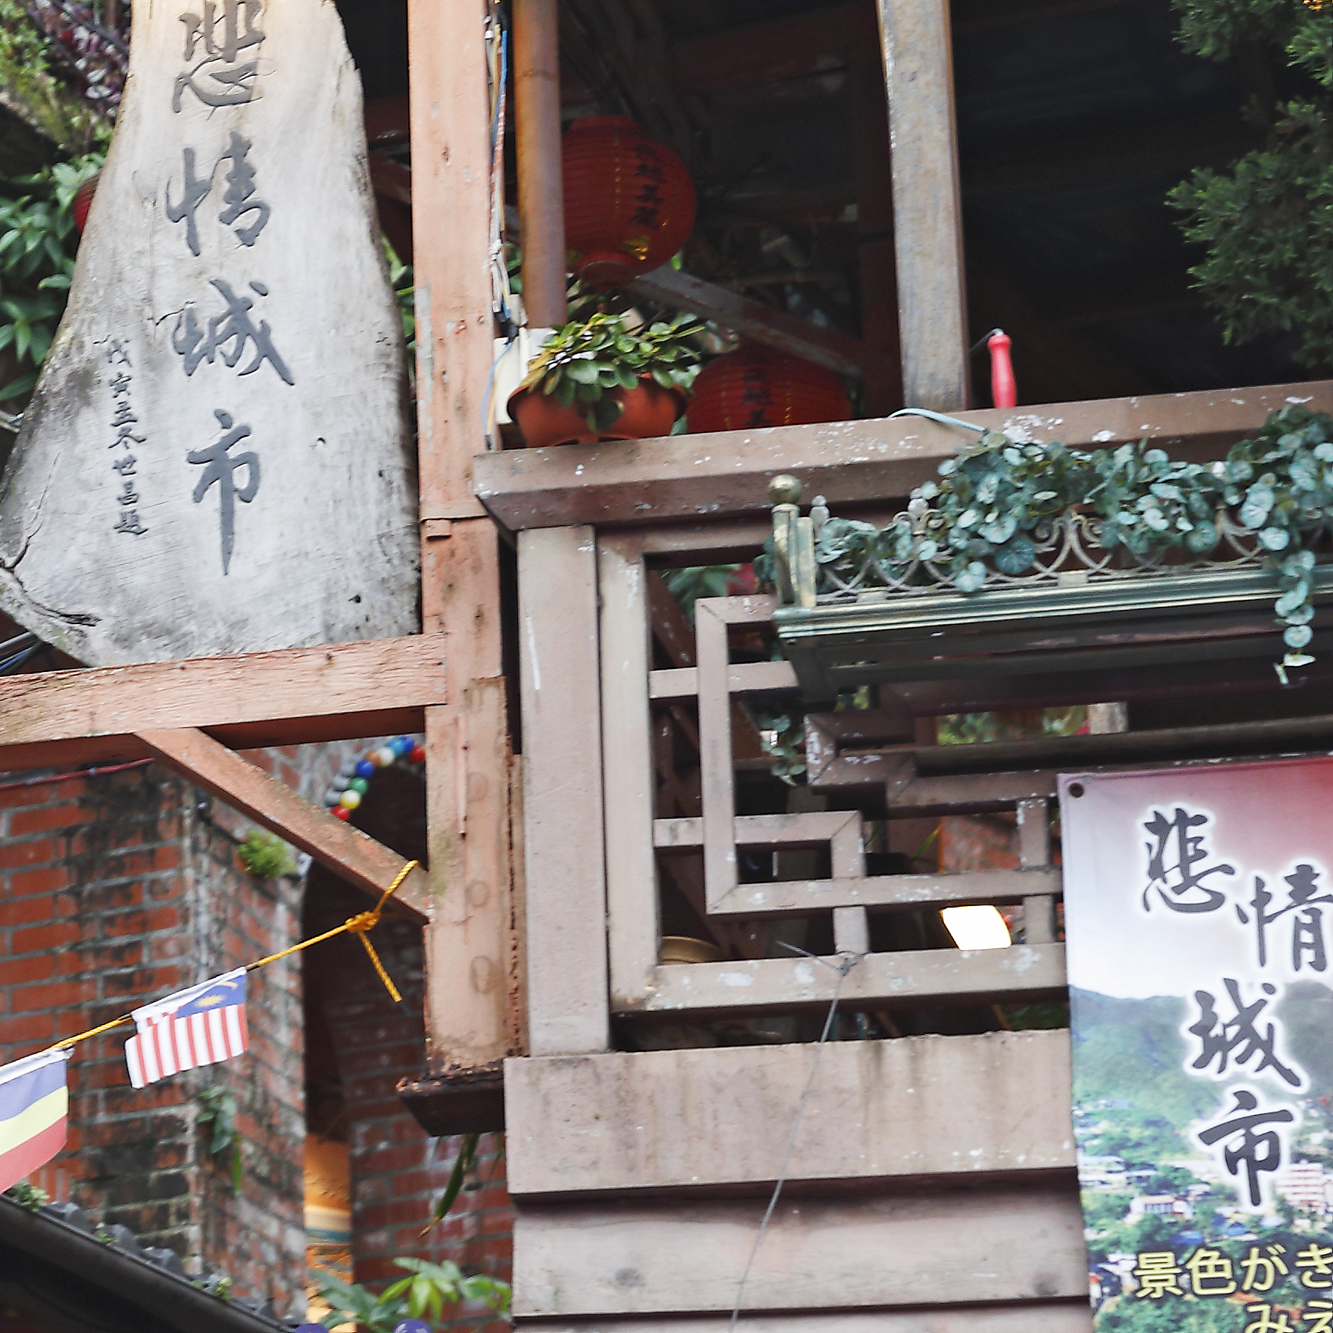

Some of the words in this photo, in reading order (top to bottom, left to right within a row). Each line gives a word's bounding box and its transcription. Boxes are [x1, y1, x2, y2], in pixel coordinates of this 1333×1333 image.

[1140, 805, 1333, 1209] 悲情城市
[1132, 1242, 1333, 1299] 景色がき
